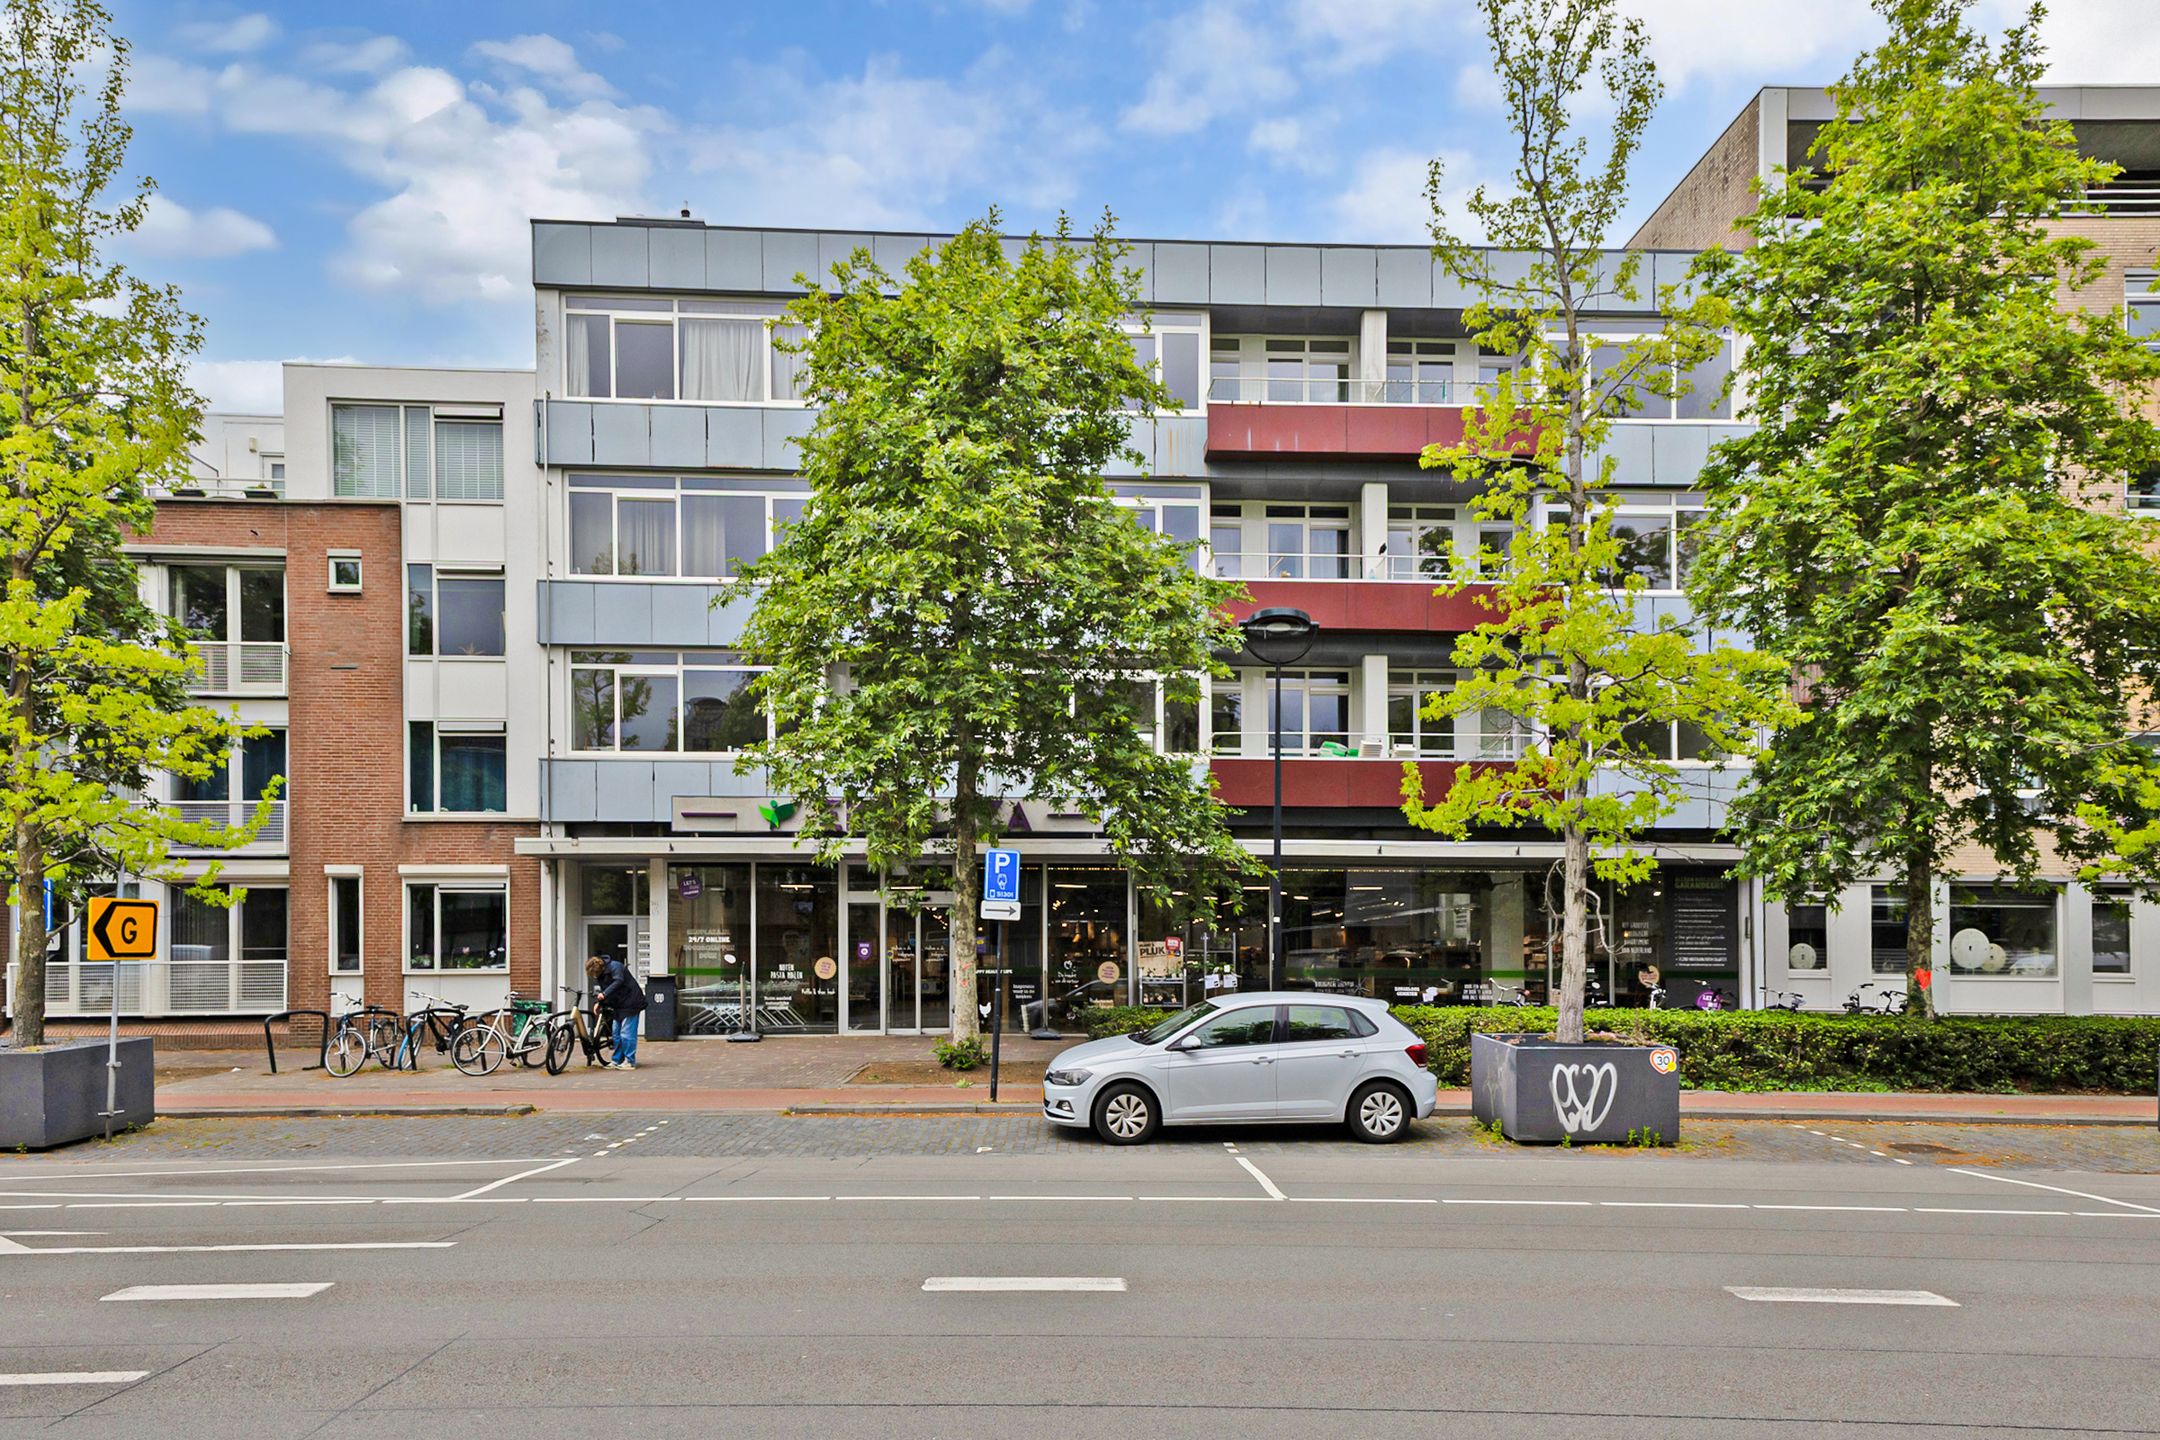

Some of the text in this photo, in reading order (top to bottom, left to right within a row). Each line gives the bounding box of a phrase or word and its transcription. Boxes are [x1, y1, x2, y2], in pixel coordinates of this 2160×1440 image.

[995, 853, 1010, 874] P
[121, 917, 137, 944] G
[1140, 947, 1165, 956] PLUK
[1657, 1056, 1669, 1066] 30
